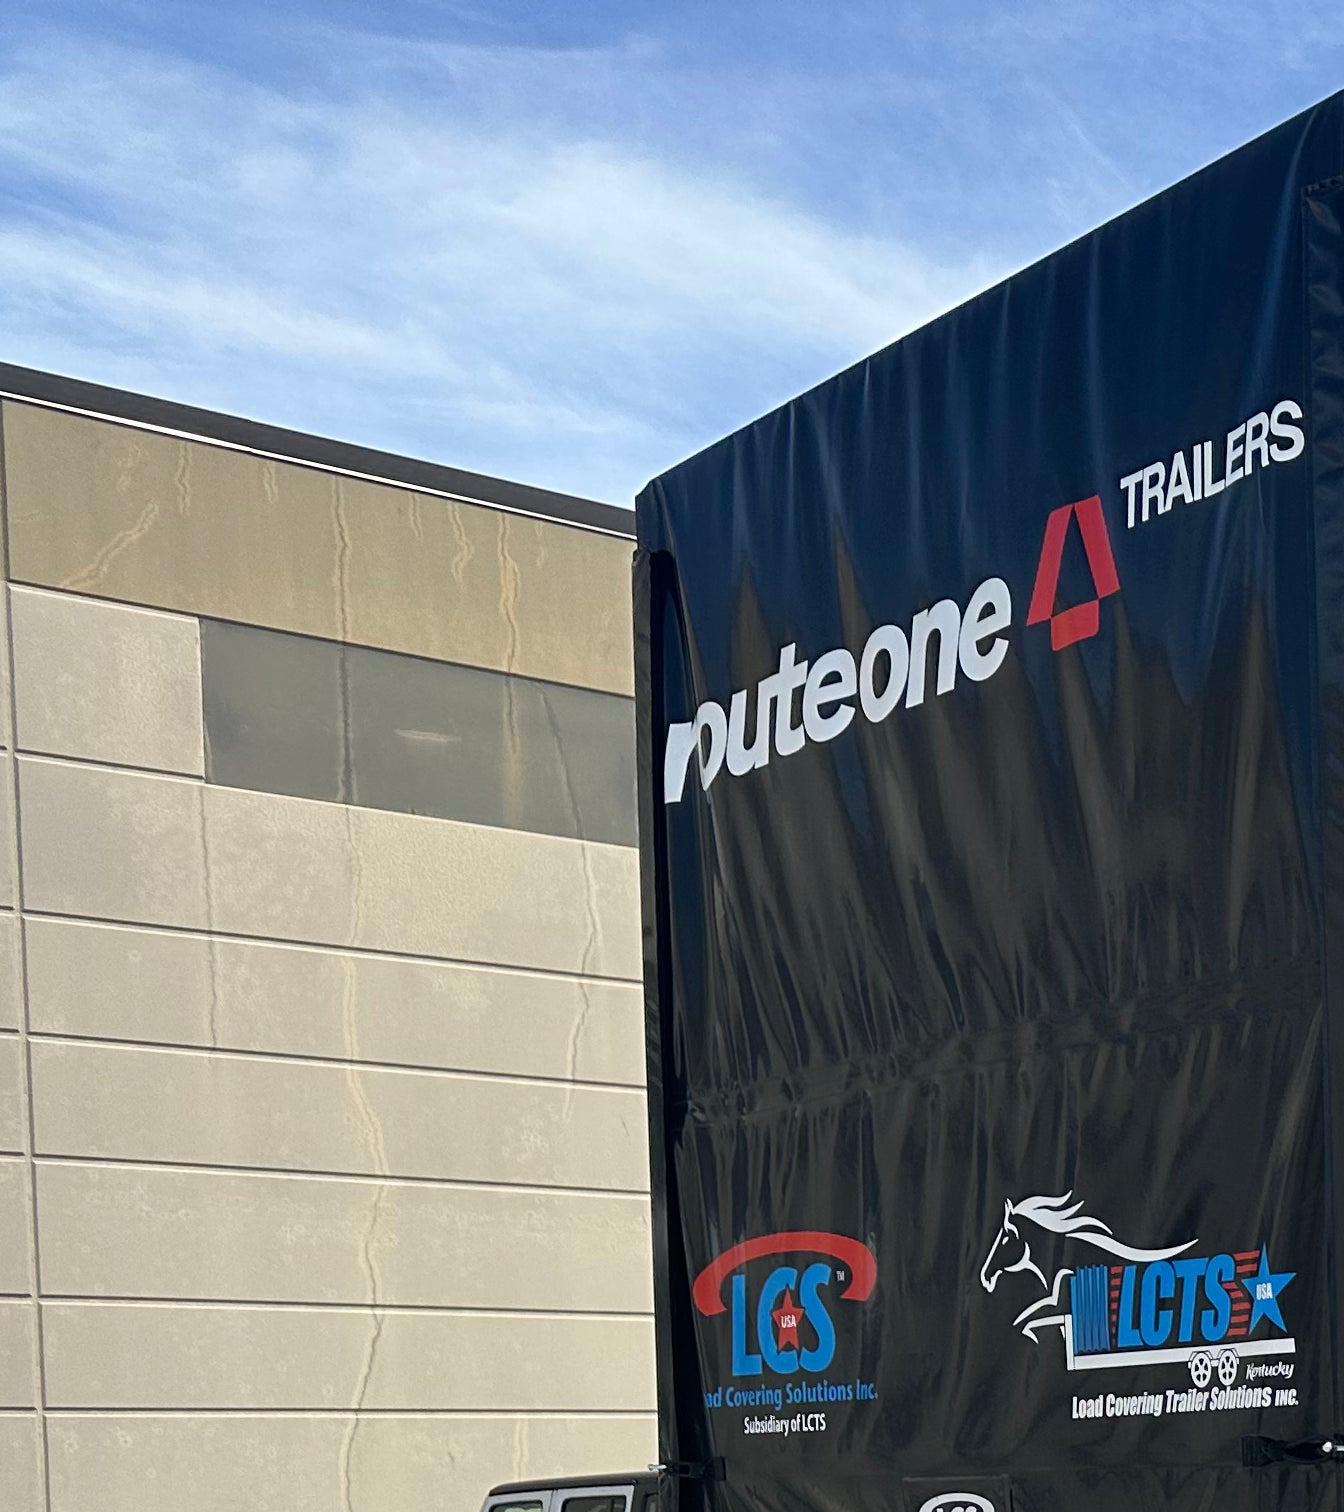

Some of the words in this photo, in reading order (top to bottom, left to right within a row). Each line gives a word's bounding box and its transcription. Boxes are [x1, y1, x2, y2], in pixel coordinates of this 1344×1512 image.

[1120, 399, 1304, 529] TRAILERS
[663, 576, 1012, 804] routeone
[732, 1263, 836, 1377] LCS
[780, 1315, 797, 1328] USA
[1117, 1254, 1236, 1348] LCTS
[1256, 1283, 1272, 1300] USA
[726, 1384, 782, 1411] Covering
[786, 1380, 853, 1404] Solutions
[856, 1379, 879, 1400] Inc.
[744, 1414, 790, 1437] Subsidiary
[790, 1413, 801, 1431] of
[802, 1413, 826, 1431] LCTS
[1072, 1395, 1103, 1419] Load
[1105, 1391, 1162, 1417] Covering
[1165, 1388, 1209, 1414] Trailer
[1209, 1385, 1271, 1410] Solutions
[1275, 1388, 1299, 1406] INC.
